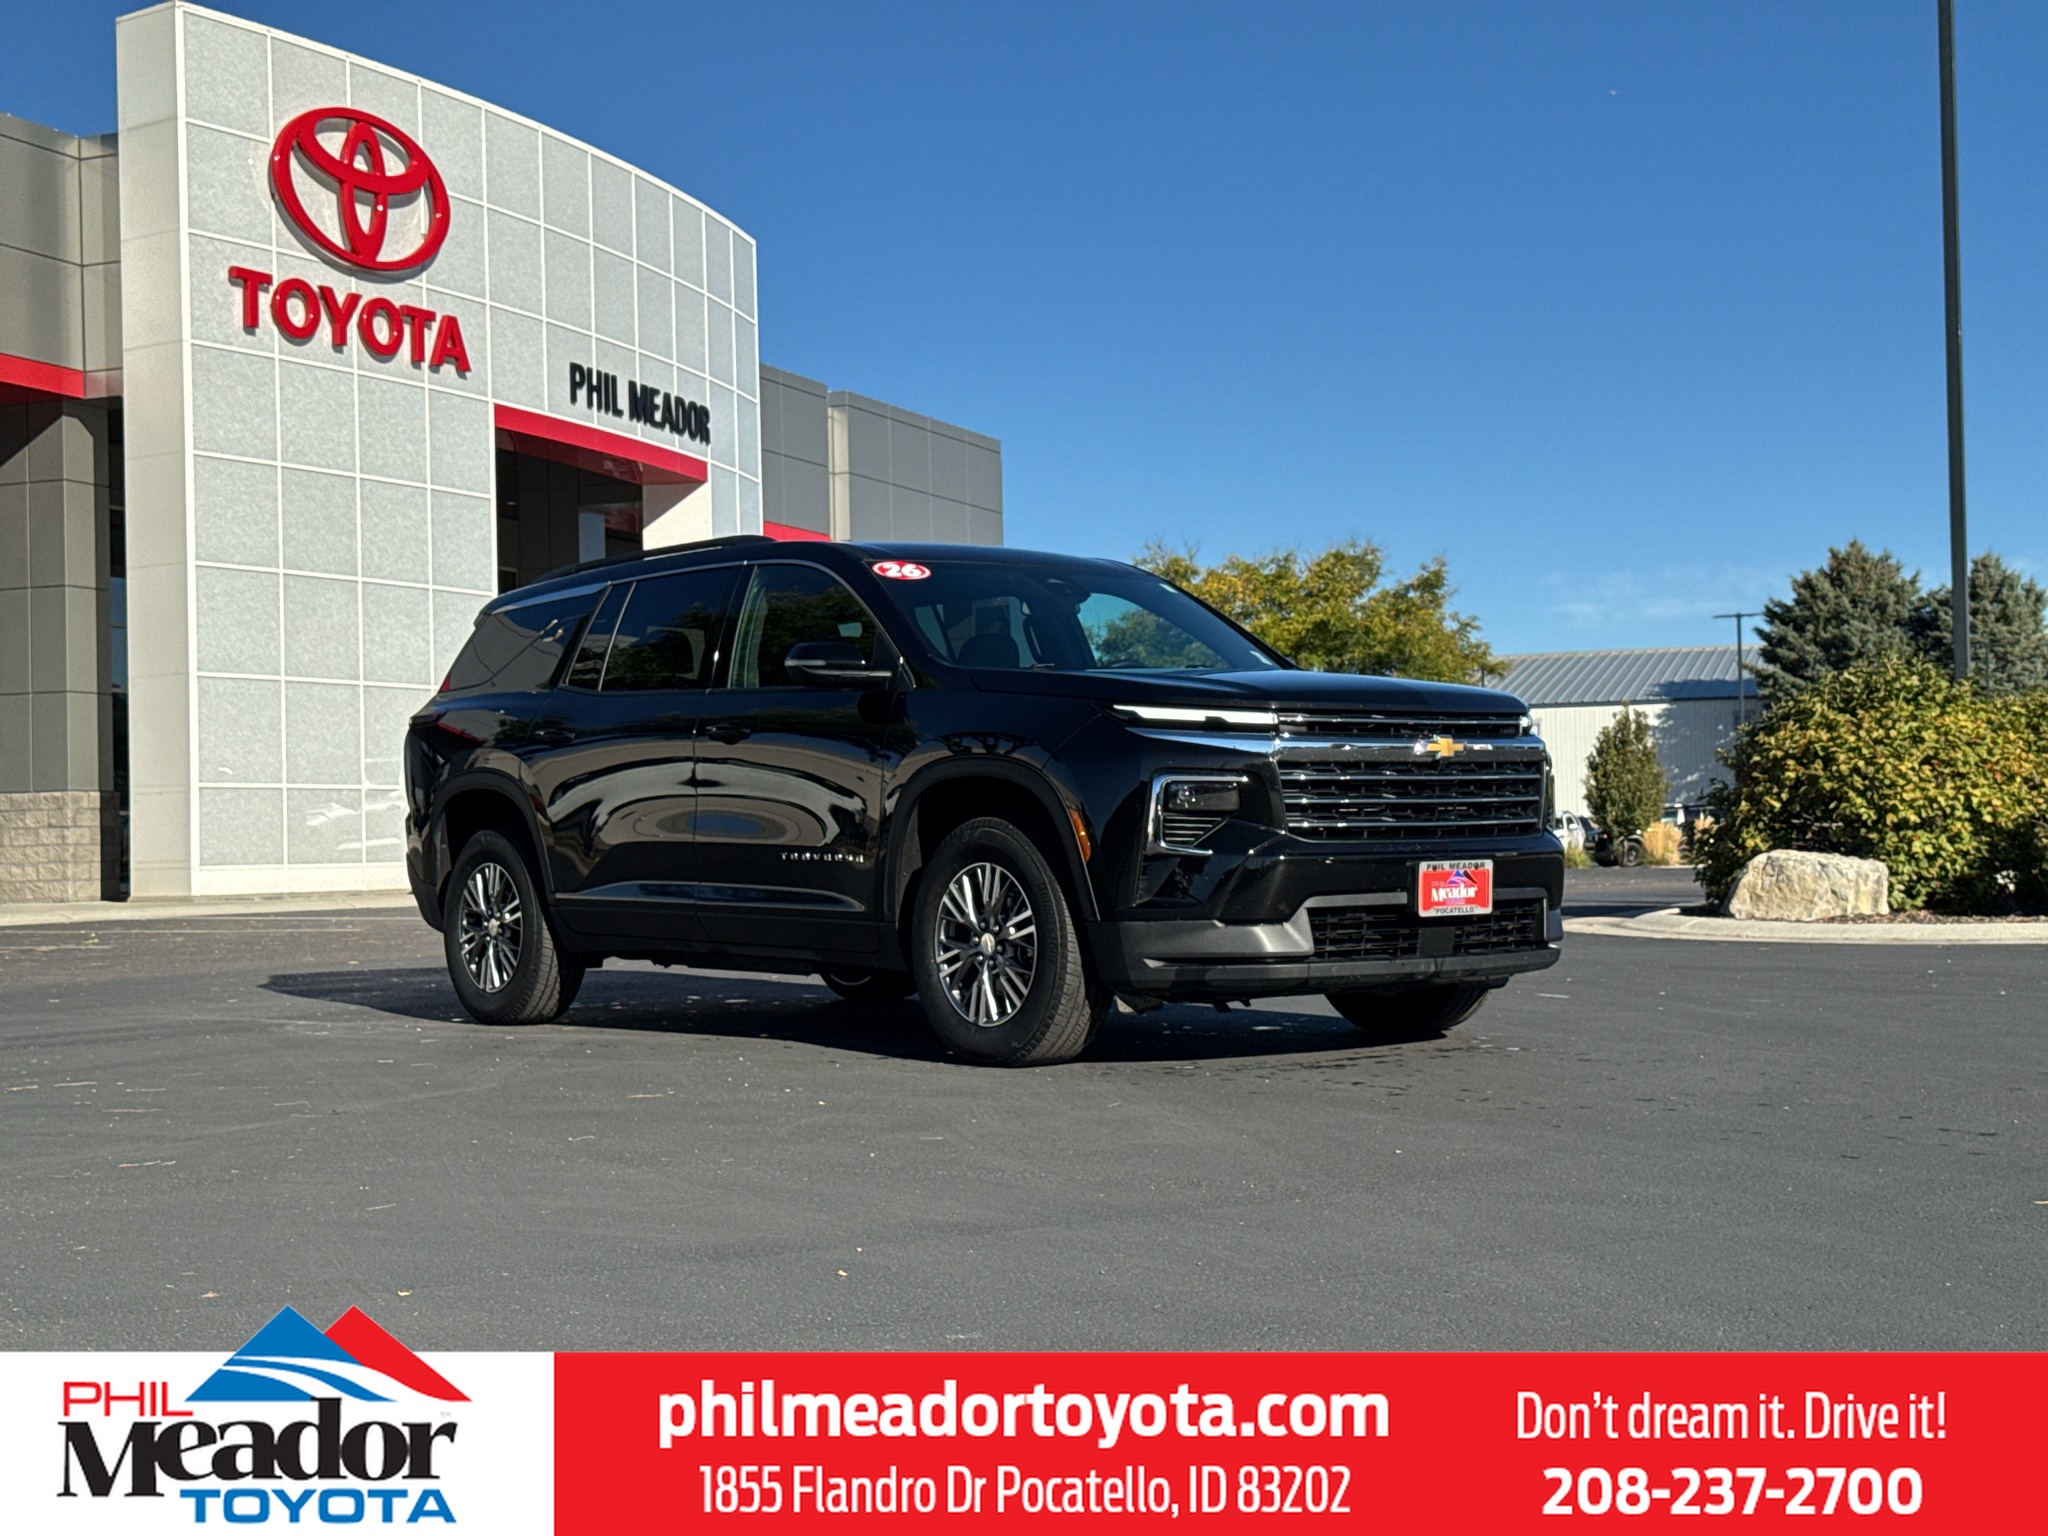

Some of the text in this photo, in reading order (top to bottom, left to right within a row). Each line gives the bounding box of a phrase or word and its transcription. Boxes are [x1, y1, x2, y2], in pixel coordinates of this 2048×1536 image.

[228, 264, 470, 373] TOYOTA
[570, 362, 711, 445] PHIL MEADOR
[881, 562, 923, 578] 26
